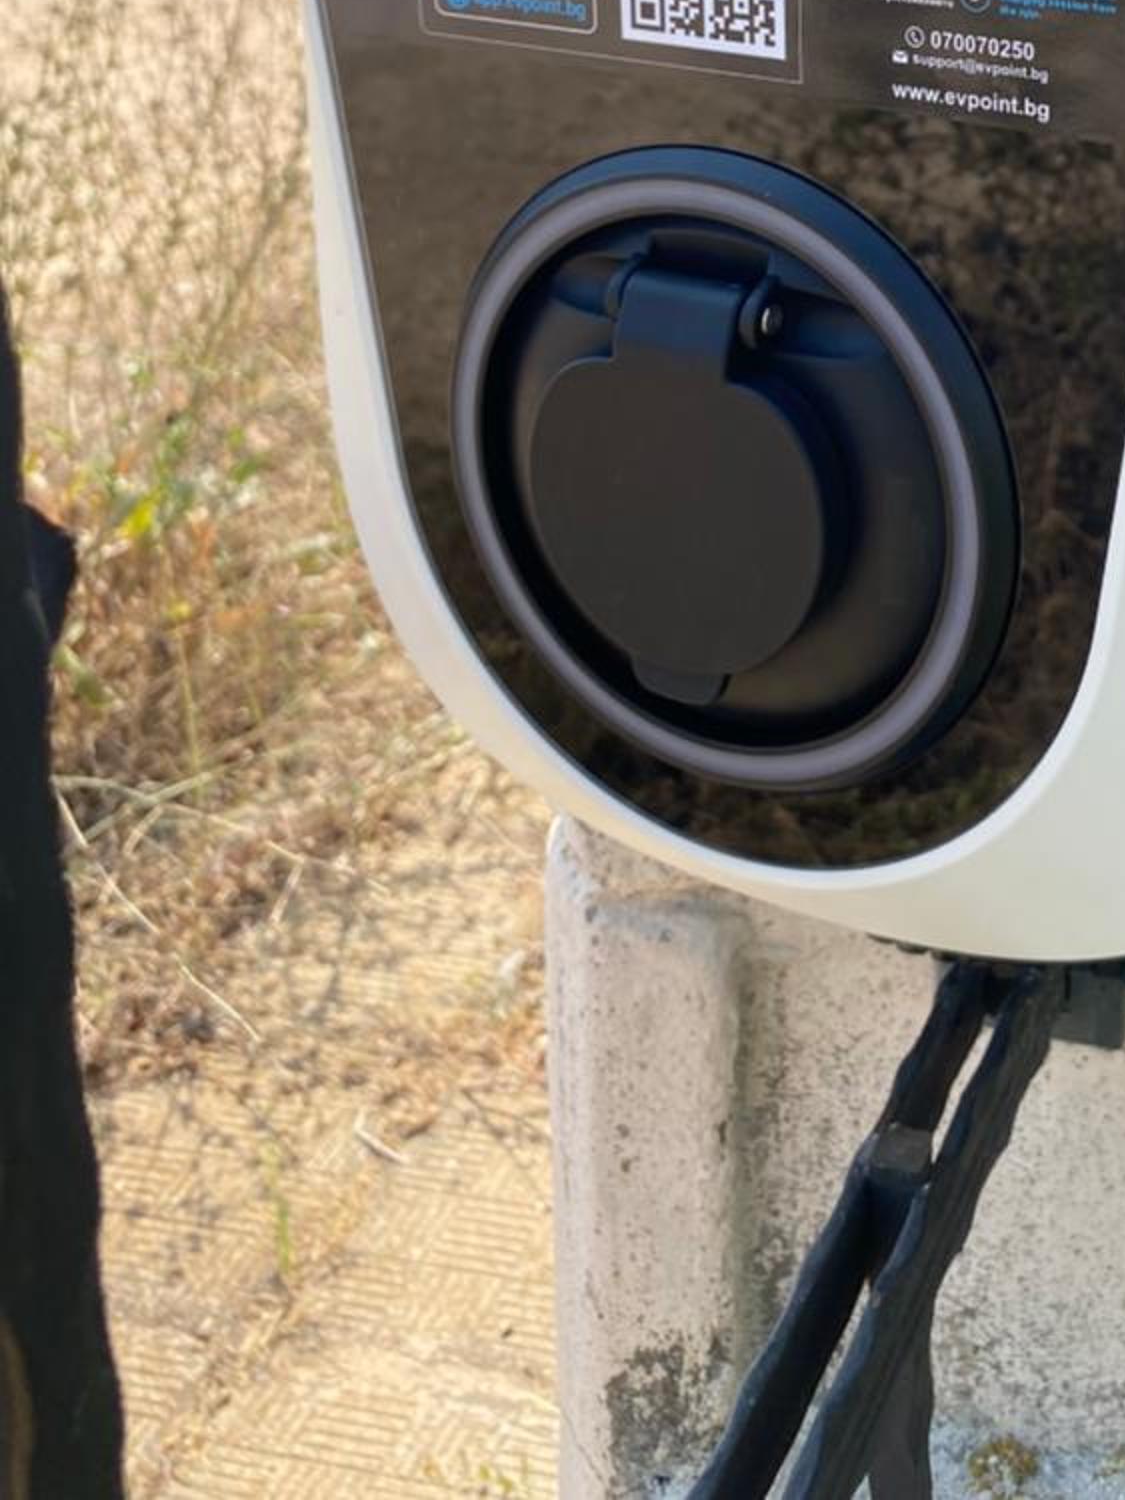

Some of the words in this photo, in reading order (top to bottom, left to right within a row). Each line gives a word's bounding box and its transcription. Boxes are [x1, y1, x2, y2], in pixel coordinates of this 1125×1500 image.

[930, 30, 1035, 61] 070070250
[912, 54, 1049, 85] support@evpoint.bg
[892, 84, 1050, 124] www.evpoint.bg
